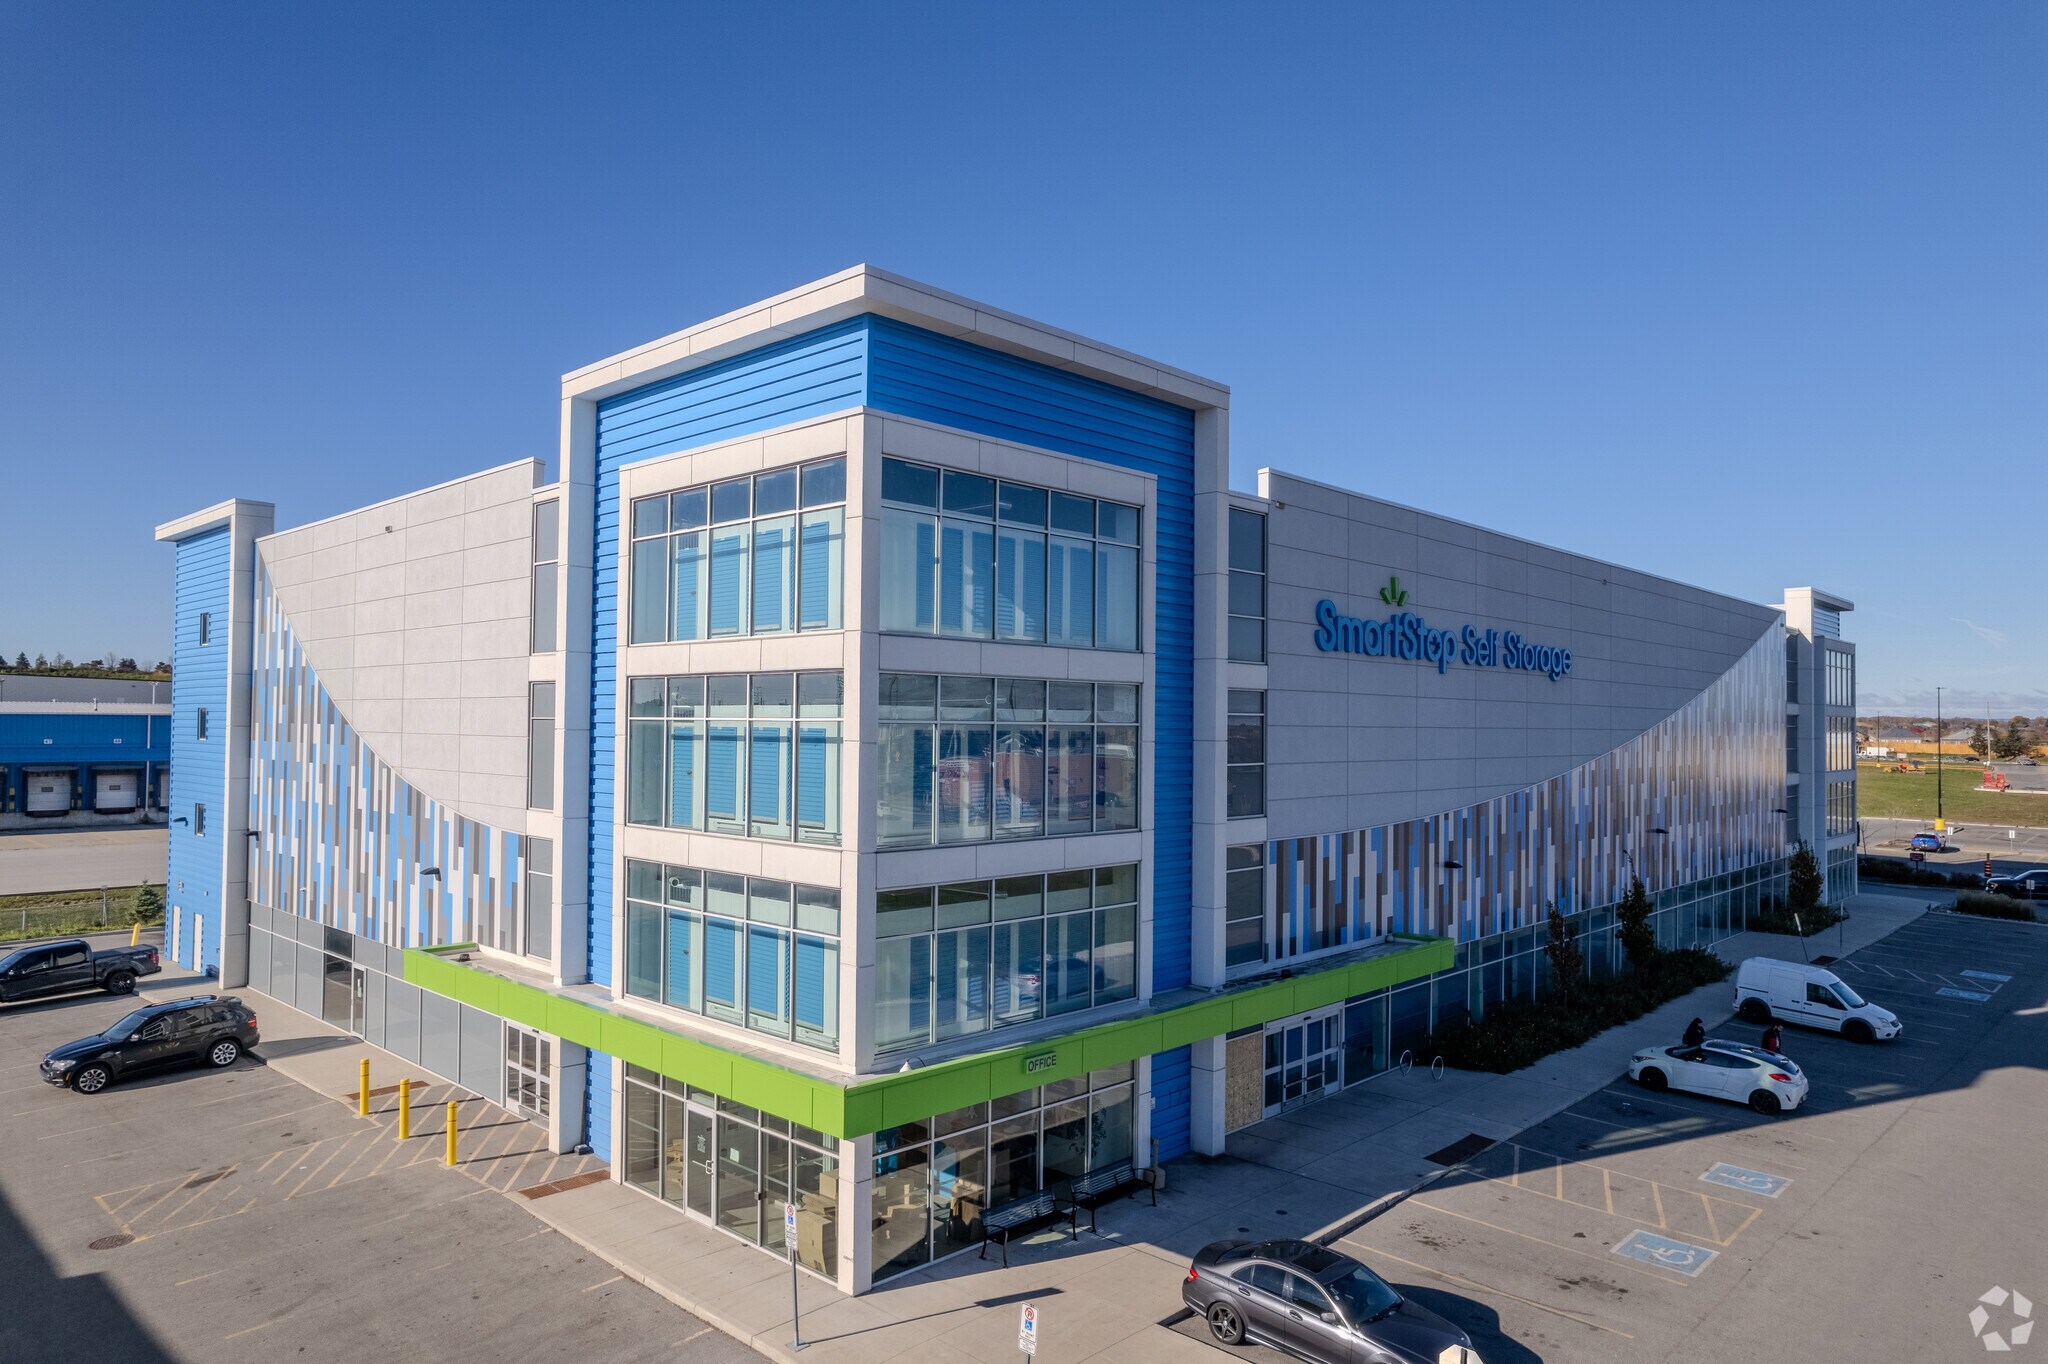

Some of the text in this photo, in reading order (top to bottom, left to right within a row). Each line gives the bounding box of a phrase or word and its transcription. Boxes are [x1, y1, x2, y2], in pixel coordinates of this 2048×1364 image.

[1315, 599, 1572, 681] SmartStop Self Storage
[1028, 1055, 1056, 1071] OFFICE
